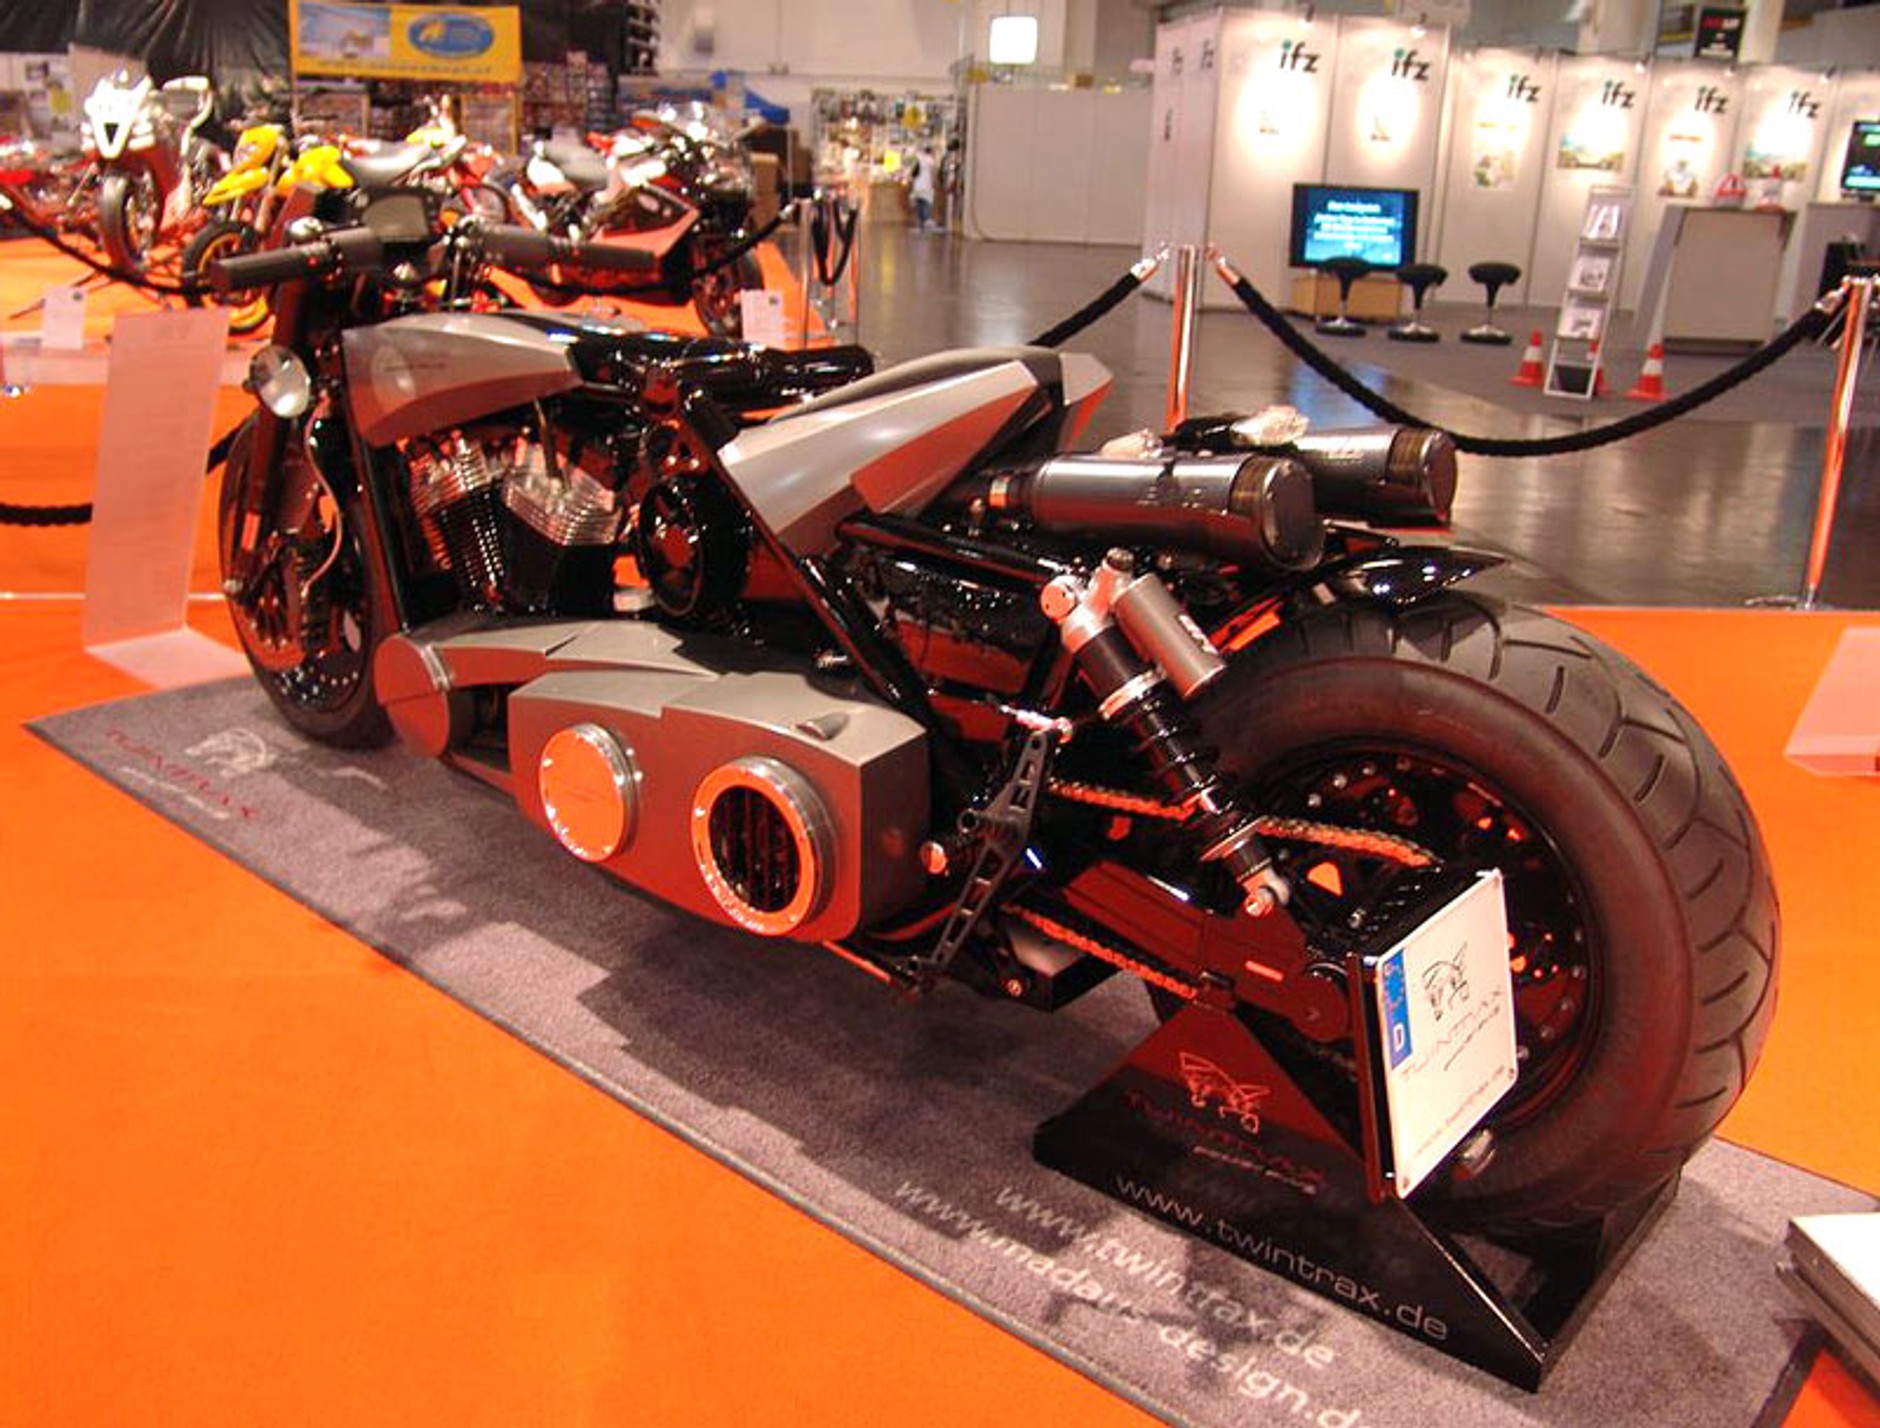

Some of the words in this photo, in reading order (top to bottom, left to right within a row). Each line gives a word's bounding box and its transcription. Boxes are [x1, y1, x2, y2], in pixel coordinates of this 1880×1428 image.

[1279, 39, 1321, 74] ifz
[1391, 47, 1431, 82] ifz
[1506, 74, 1541, 104] ifz
[1602, 80, 1637, 110] ifz
[1694, 86, 1730, 115] ifz
[1787, 90, 1822, 120] ifz
[1115, 1175, 1450, 1341] www.twintrax.de
[995, 1185, 1337, 1367] www.twintrax.de
